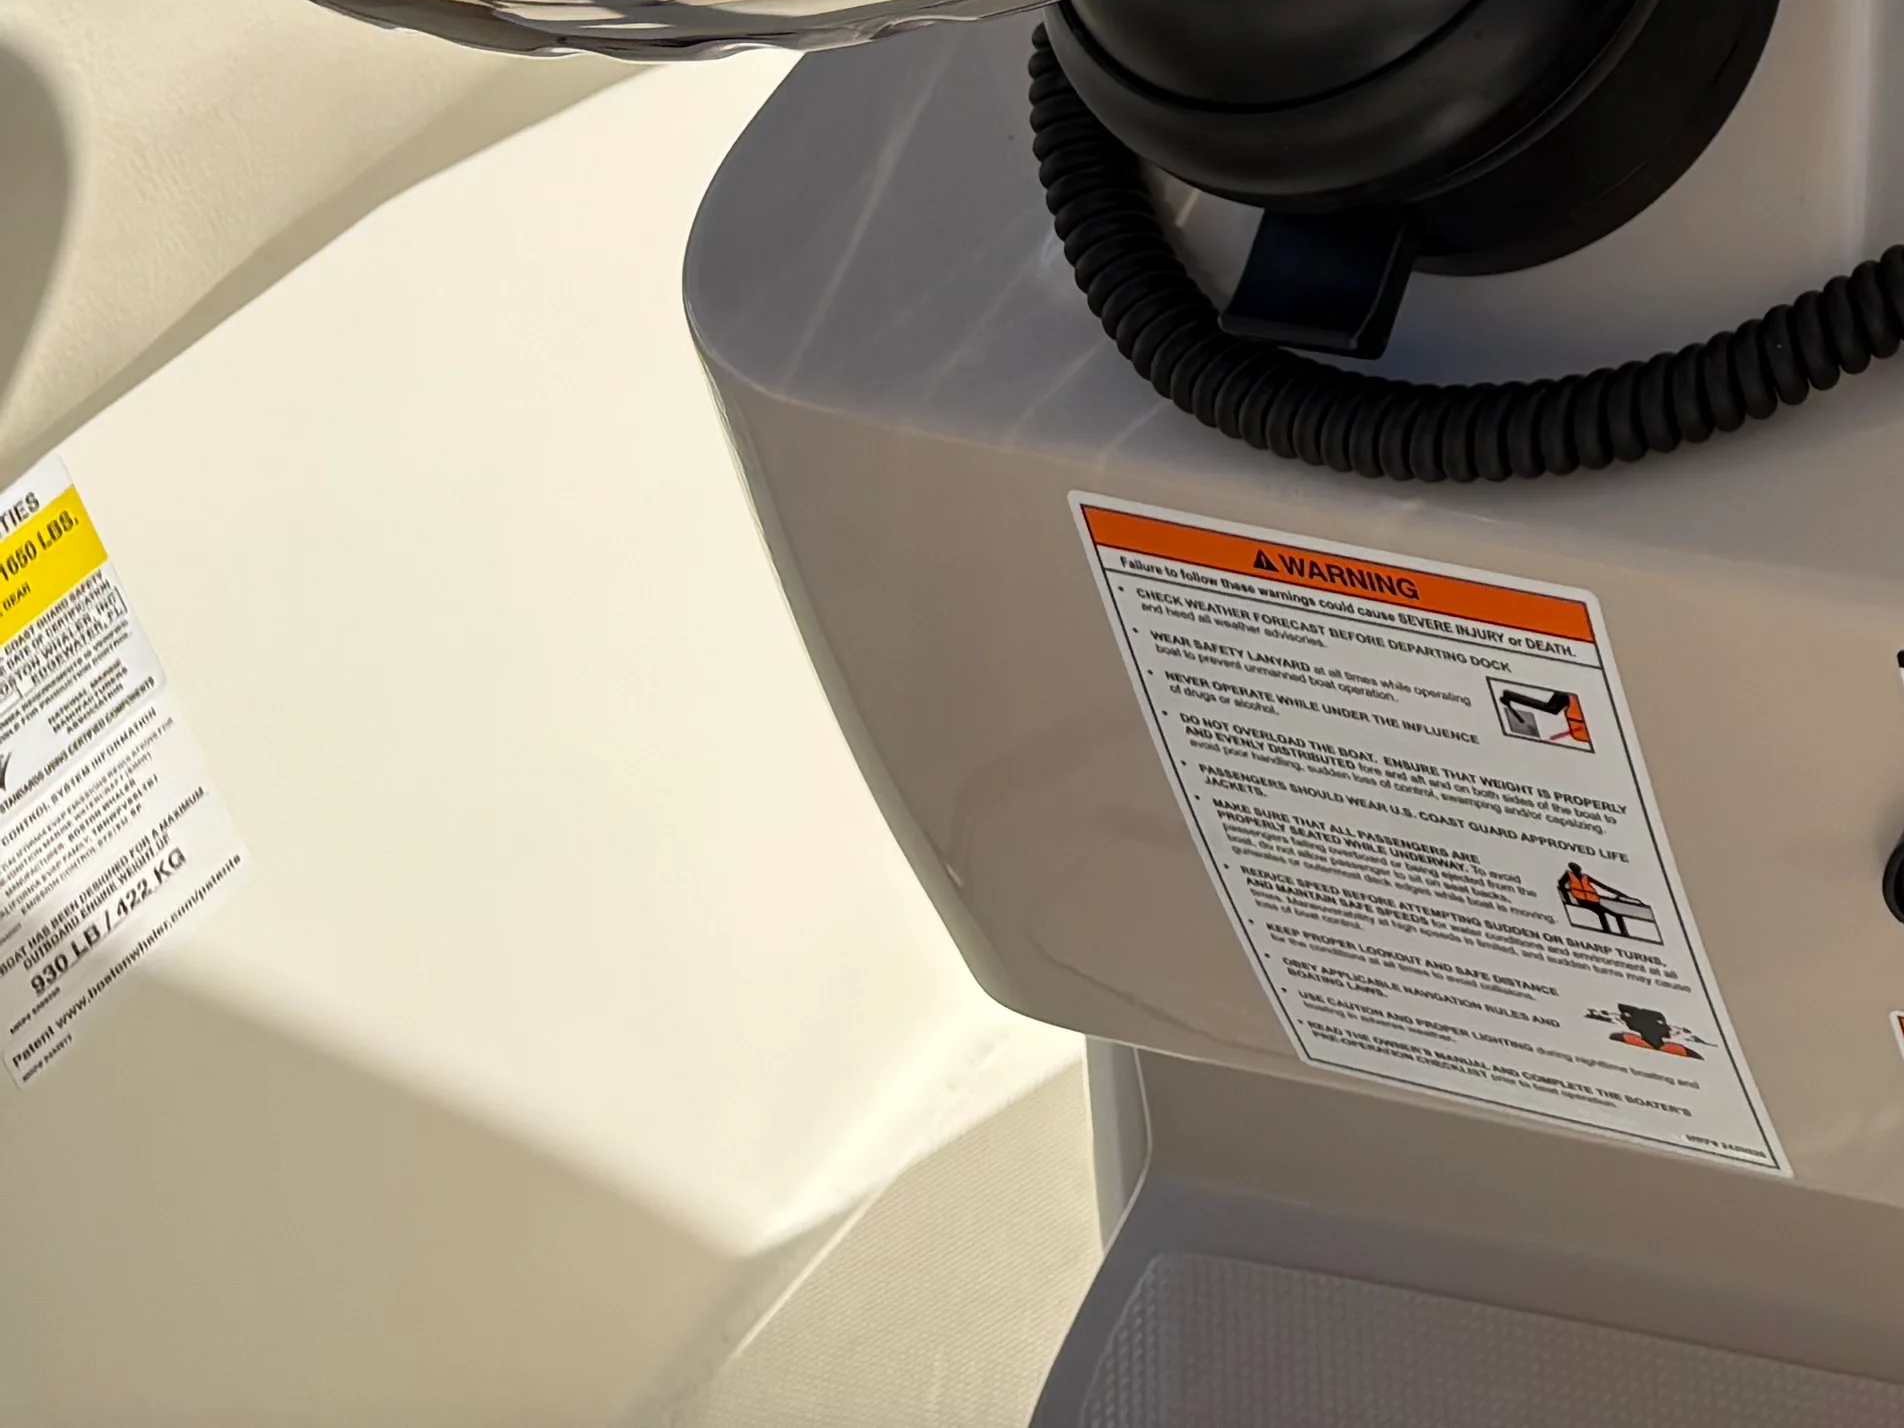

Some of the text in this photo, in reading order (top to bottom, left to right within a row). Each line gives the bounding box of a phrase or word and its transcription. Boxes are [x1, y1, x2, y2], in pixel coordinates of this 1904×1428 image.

[0, 491, 40, 533] TIES
[1118, 555, 1577, 659] Failure to follow these warnings could cause SEVERE INJURY or DEATH.
[1277, 553, 1421, 601] WARNING
[1134, 587, 1512, 673] CHECK WEATHER FORECAST BEFORE DEPARTING DOCK
[1149, 629, 1311, 673] WEAR SAFETY LANYARD
[1163, 670, 1480, 745] NEVER OPERATE WHILE UNDER THE INFLUENCE
[28, 844, 187, 998] 930 LB / 422 KG
